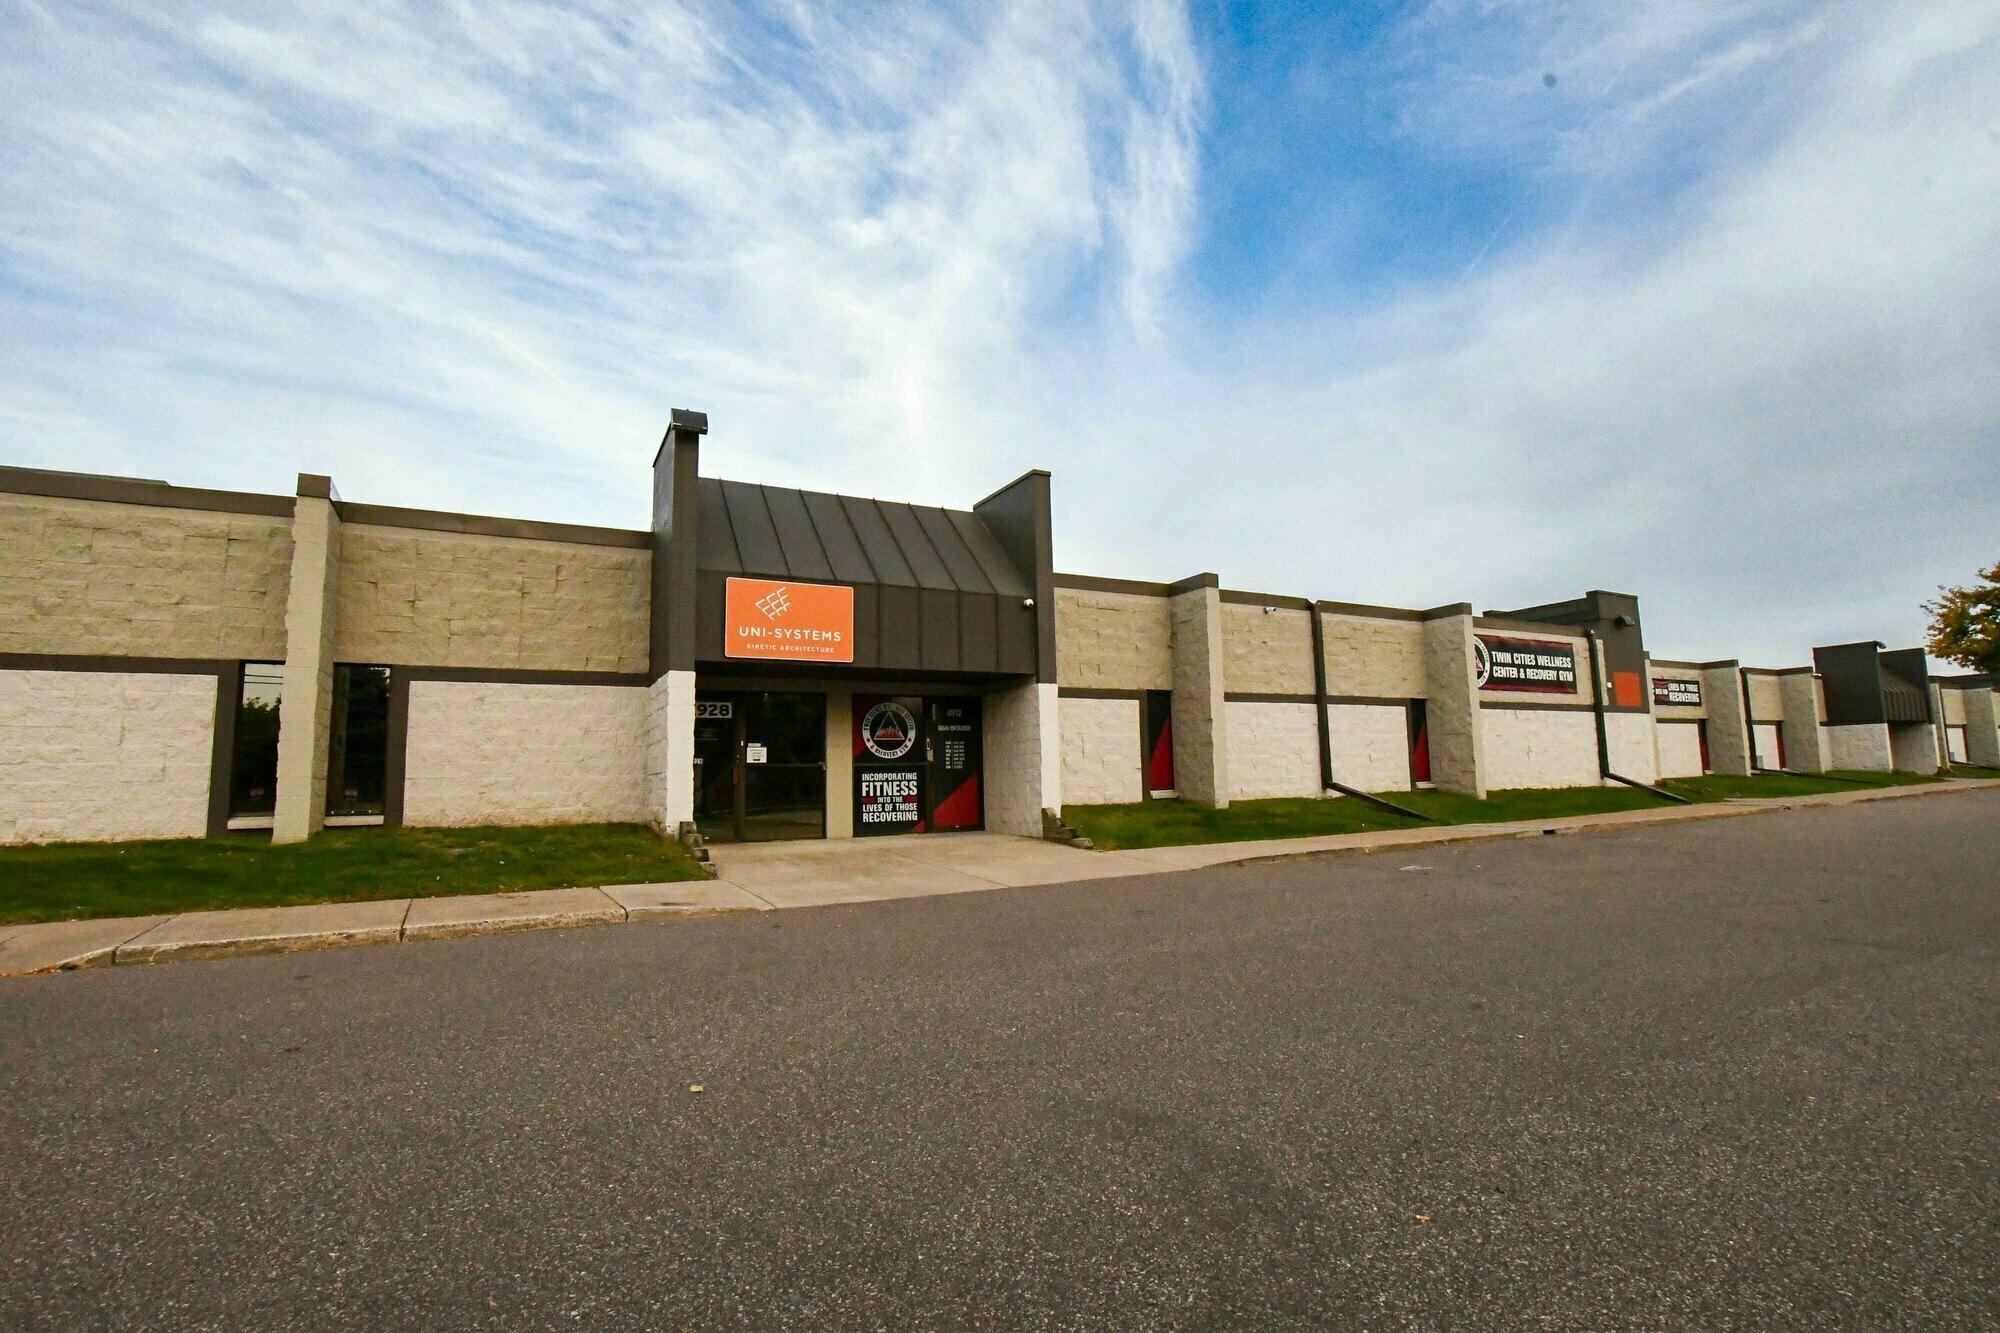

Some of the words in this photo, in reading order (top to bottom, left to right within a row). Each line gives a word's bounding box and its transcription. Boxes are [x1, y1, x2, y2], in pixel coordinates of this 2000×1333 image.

[739, 626, 842, 642] UNI-SYSTEMS
[746, 643, 777, 651] KINETIC
[780, 645, 835, 654] ARCHITECTURE
[1491, 651, 1512, 664] TWIN
[1513, 653, 1536, 666] CITIES
[1536, 655, 1572, 669] WELLNESS
[1492, 666, 1518, 679] CENTER
[1519, 668, 1526, 679] &
[1526, 668, 1558, 681] RECOVERY
[1558, 670, 1574, 682] GYM
[862, 772, 918, 781] INCORPORATING
[862, 780, 918, 797] FITNESS
[862, 804, 883, 812] LIVES
[884, 803, 894, 811] OF
[895, 802, 918, 811] THOSE
[862, 811, 918, 823] RECOVERING
